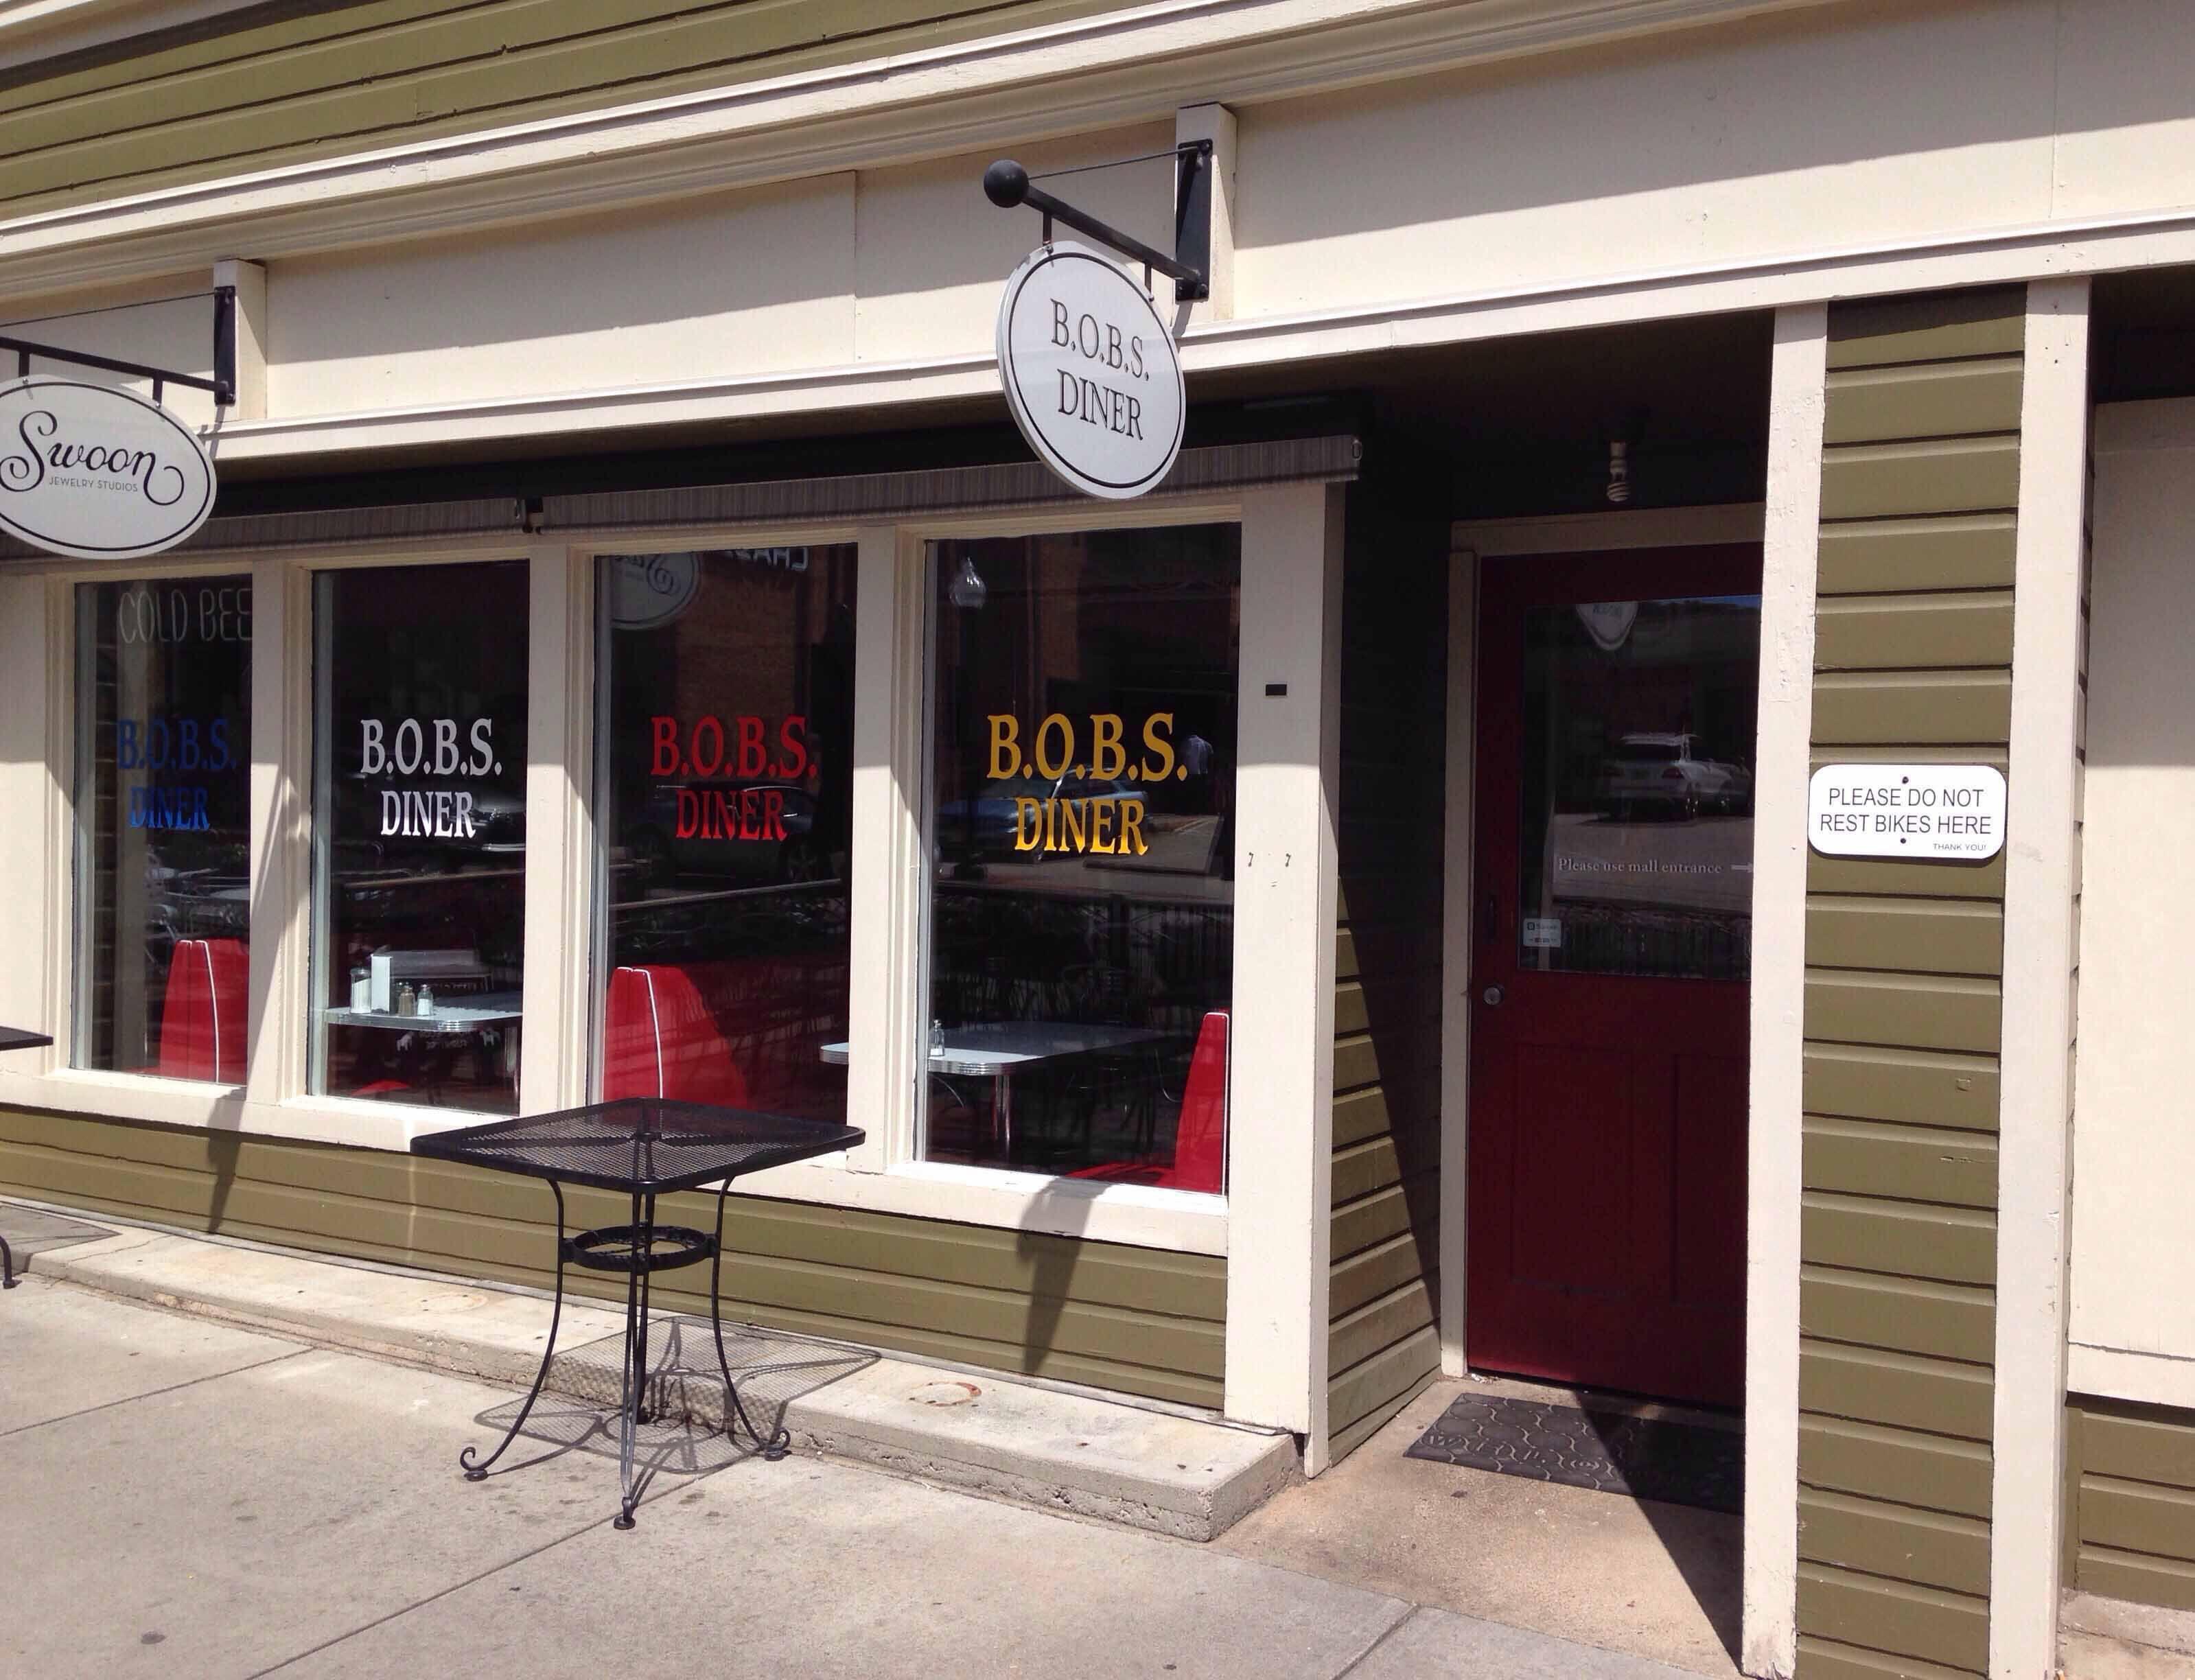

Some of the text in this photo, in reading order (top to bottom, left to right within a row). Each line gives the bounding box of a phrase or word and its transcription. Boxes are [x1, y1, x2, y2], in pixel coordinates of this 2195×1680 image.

[1050, 298, 1150, 382] B.O.B.S.
[1057, 368, 1143, 441] DINER
[0, 410, 184, 505] Swoon
[49, 476, 138, 492] JEWELRY STUDIOS
[119, 588, 188, 644] COLD
[117, 719, 236, 770] B.O.B.S.
[360, 718, 502, 776] B.O.B.S.
[651, 714, 818, 778] B.O.B.S.
[986, 712, 1188, 782] B.O.B.S.
[129, 786, 211, 831] DINER
[381, 791, 476, 838] DINER
[675, 790, 788, 842] DINER
[1828, 788, 1984, 807] PLEASE DO NOT
[1014, 796, 1149, 856] DINER
[1820, 814, 1992, 835] REST BIKES HERE
[1933, 843, 1962, 851] THANK
[1558, 858, 1722, 874] Please use mall entrance
